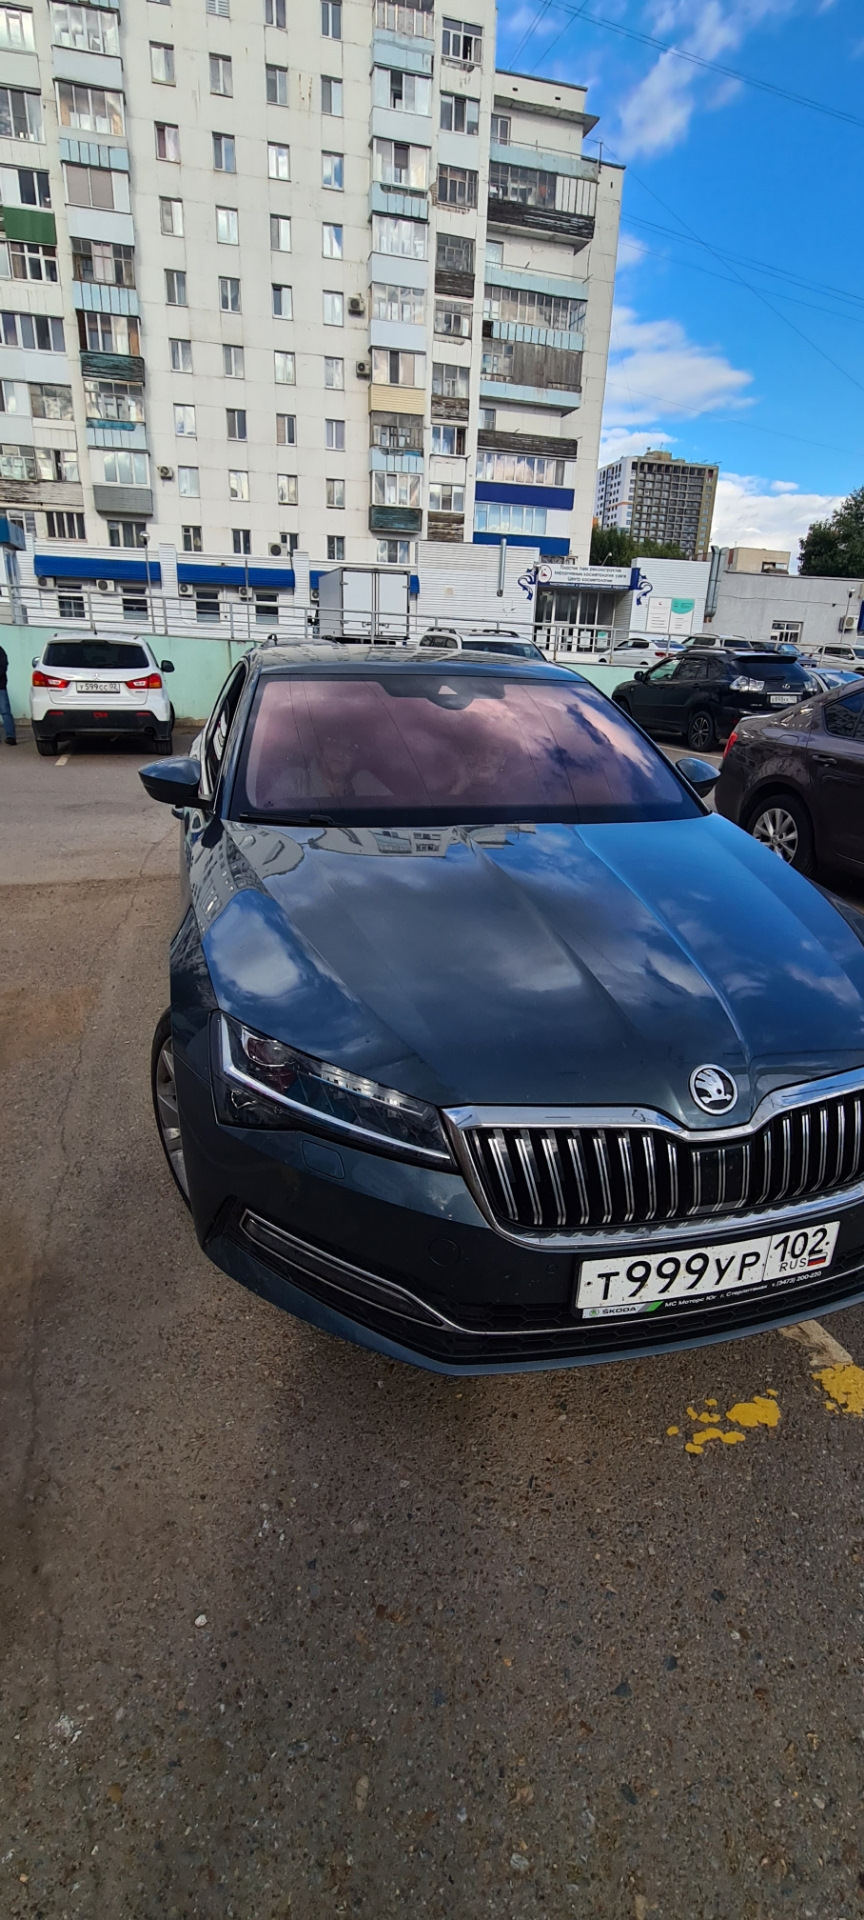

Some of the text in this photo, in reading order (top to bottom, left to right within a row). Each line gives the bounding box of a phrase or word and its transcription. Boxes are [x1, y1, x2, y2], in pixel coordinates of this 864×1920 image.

[773, 1227, 828, 1262] 102
[779, 1257, 807, 1272] RUS
[678, 1297, 705, 1305] Моторс
